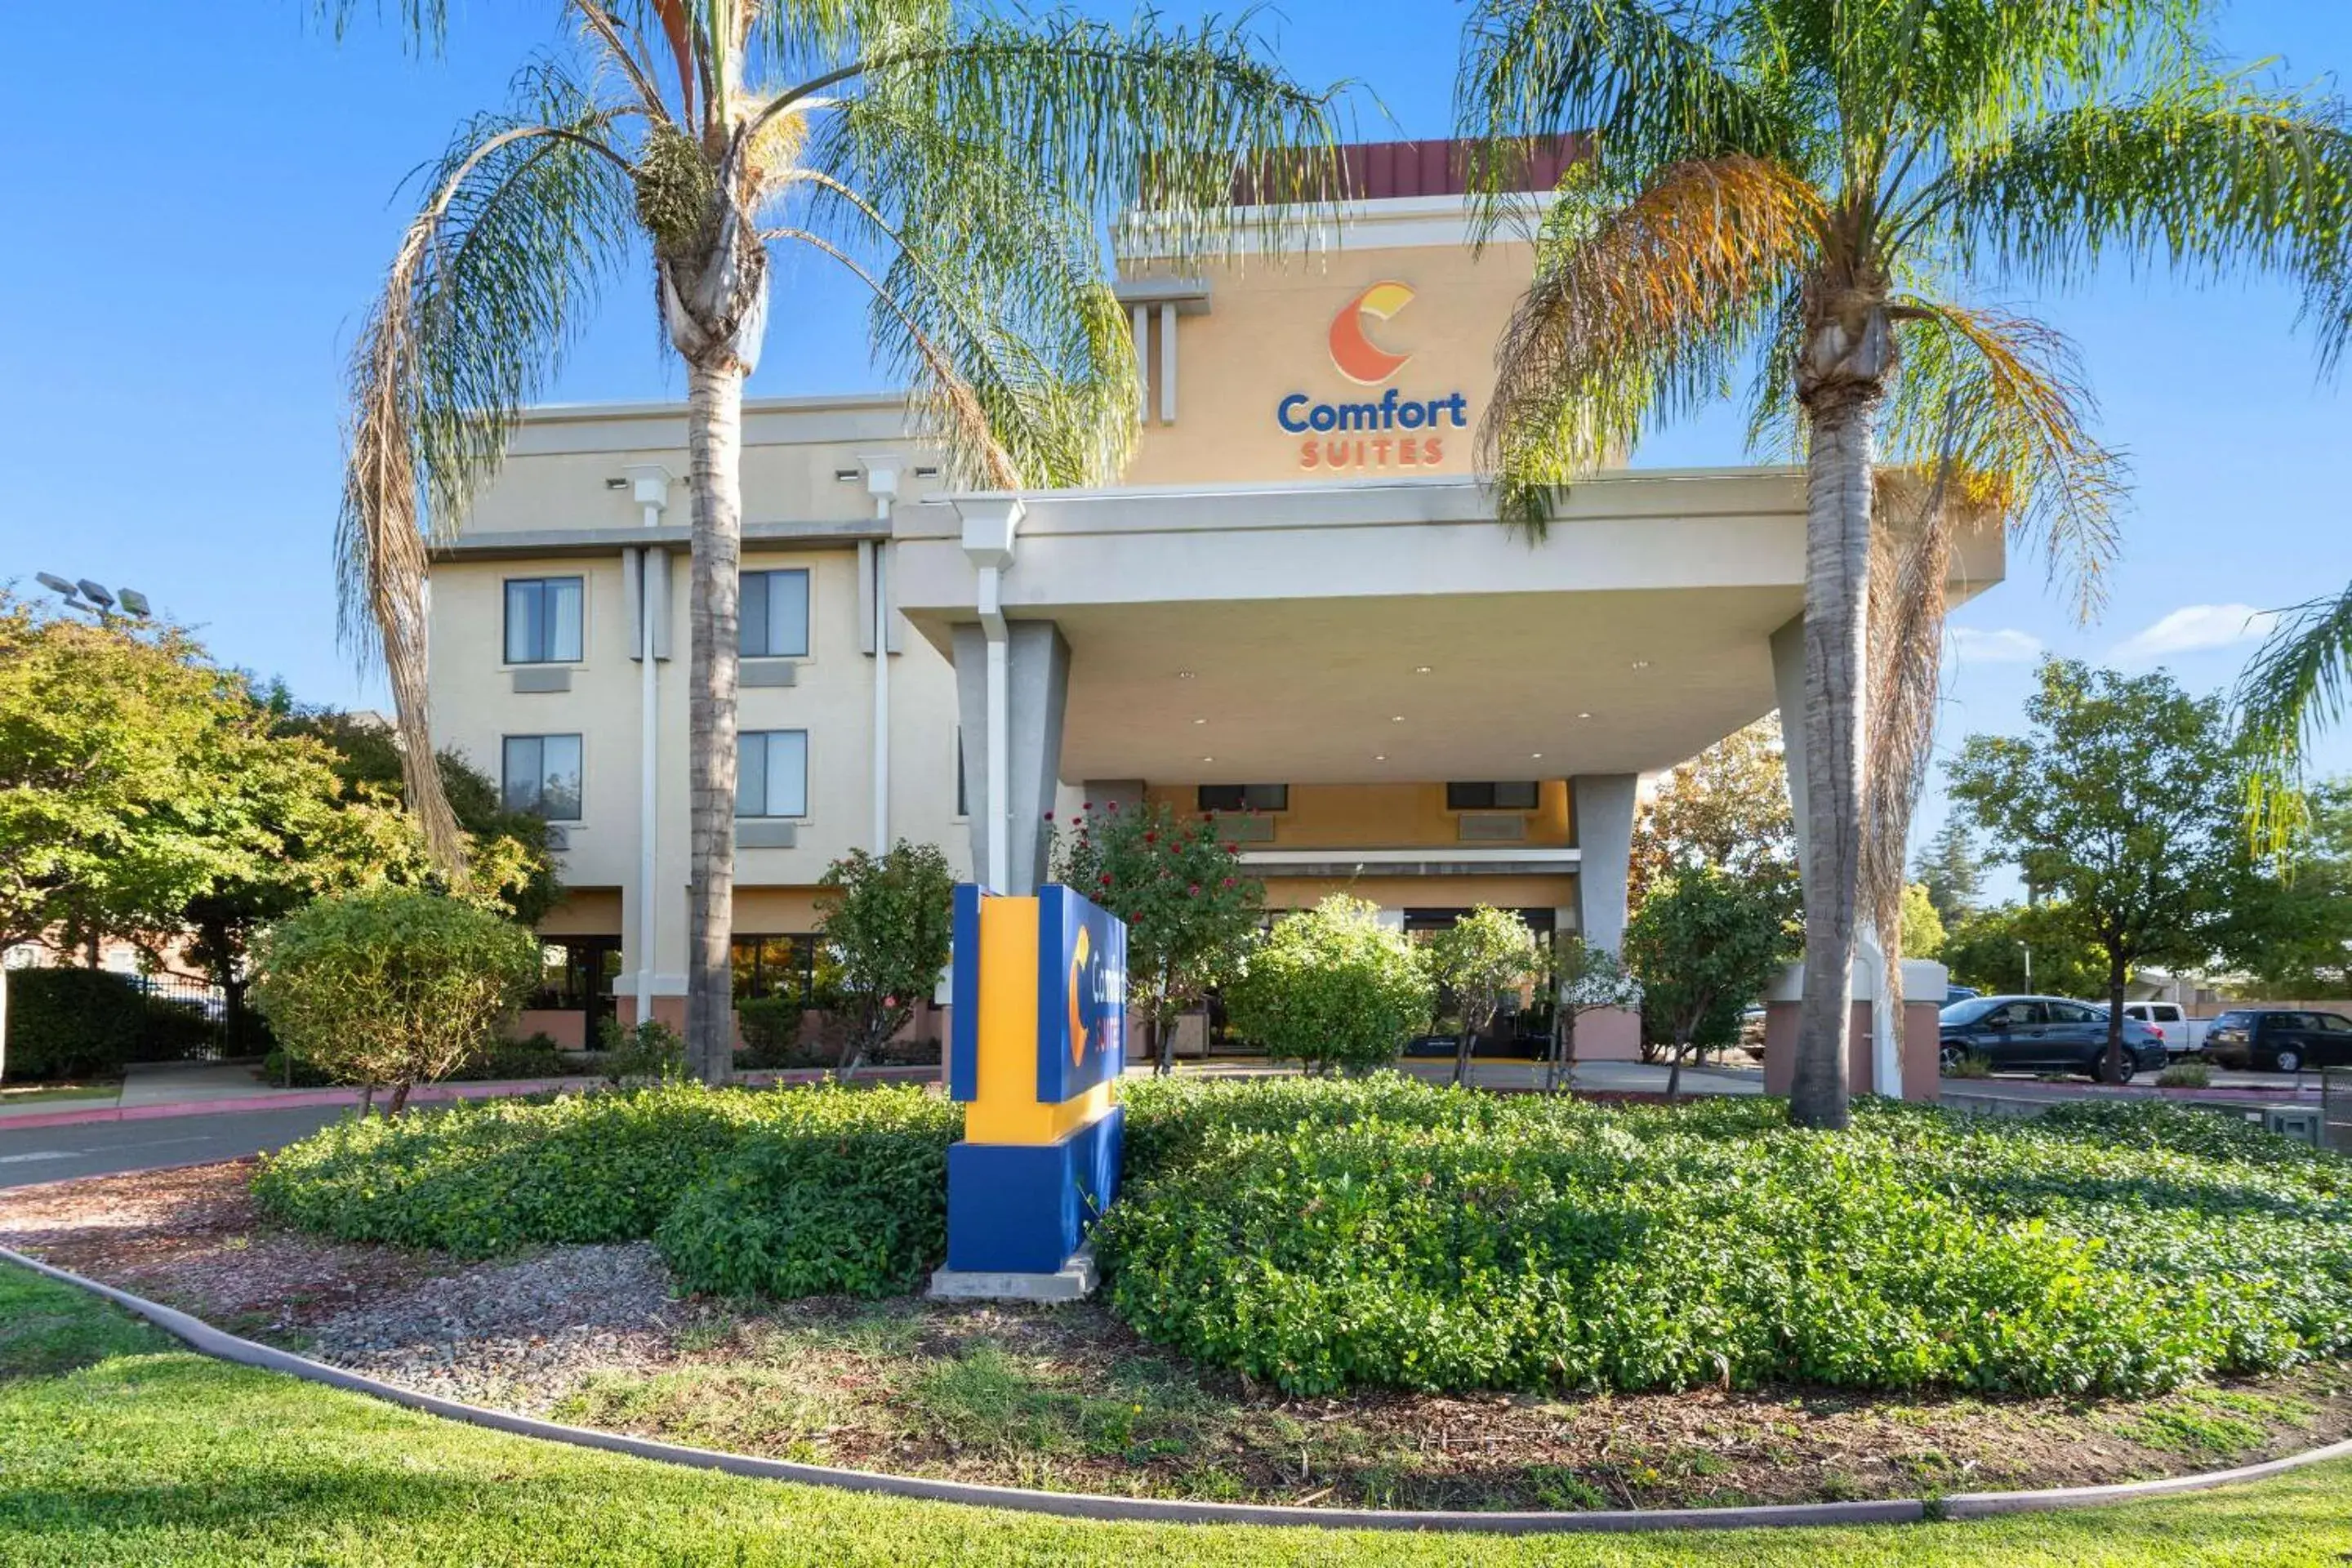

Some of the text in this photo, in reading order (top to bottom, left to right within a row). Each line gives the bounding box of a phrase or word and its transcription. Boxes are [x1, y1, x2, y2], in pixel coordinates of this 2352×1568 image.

[1277, 388, 1467, 434] Comfort
[1300, 438, 1444, 470] SUITES
[1093, 950, 1126, 1004] Comf
